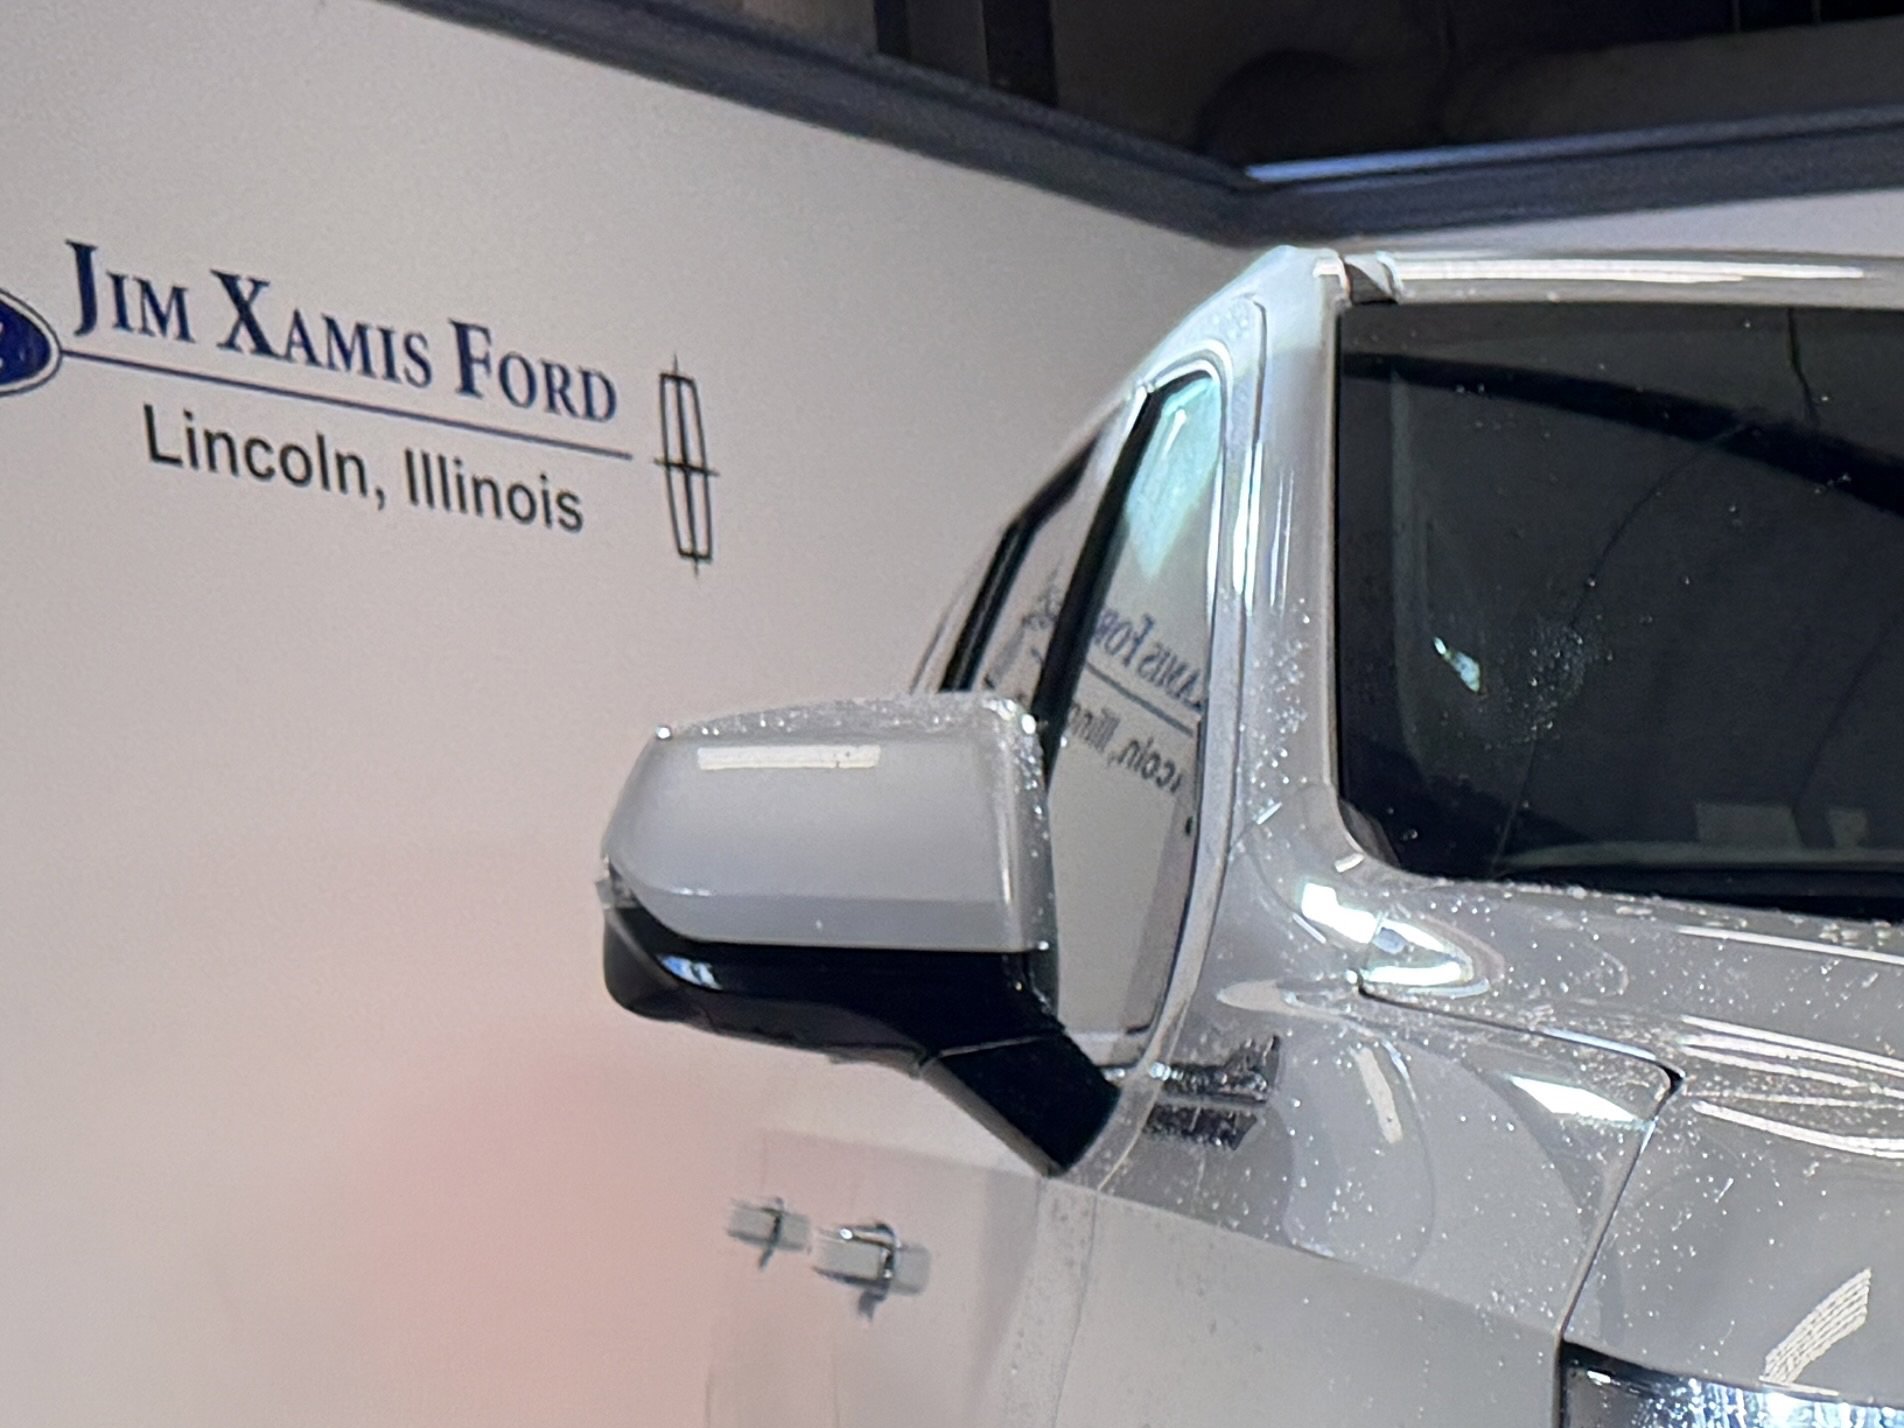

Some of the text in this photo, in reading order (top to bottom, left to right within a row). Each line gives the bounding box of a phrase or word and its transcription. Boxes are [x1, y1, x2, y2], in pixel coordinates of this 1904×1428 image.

[65, 238, 618, 423] JIM XAMIS FORD
[143, 403, 584, 533] Lincoln, Illinois
